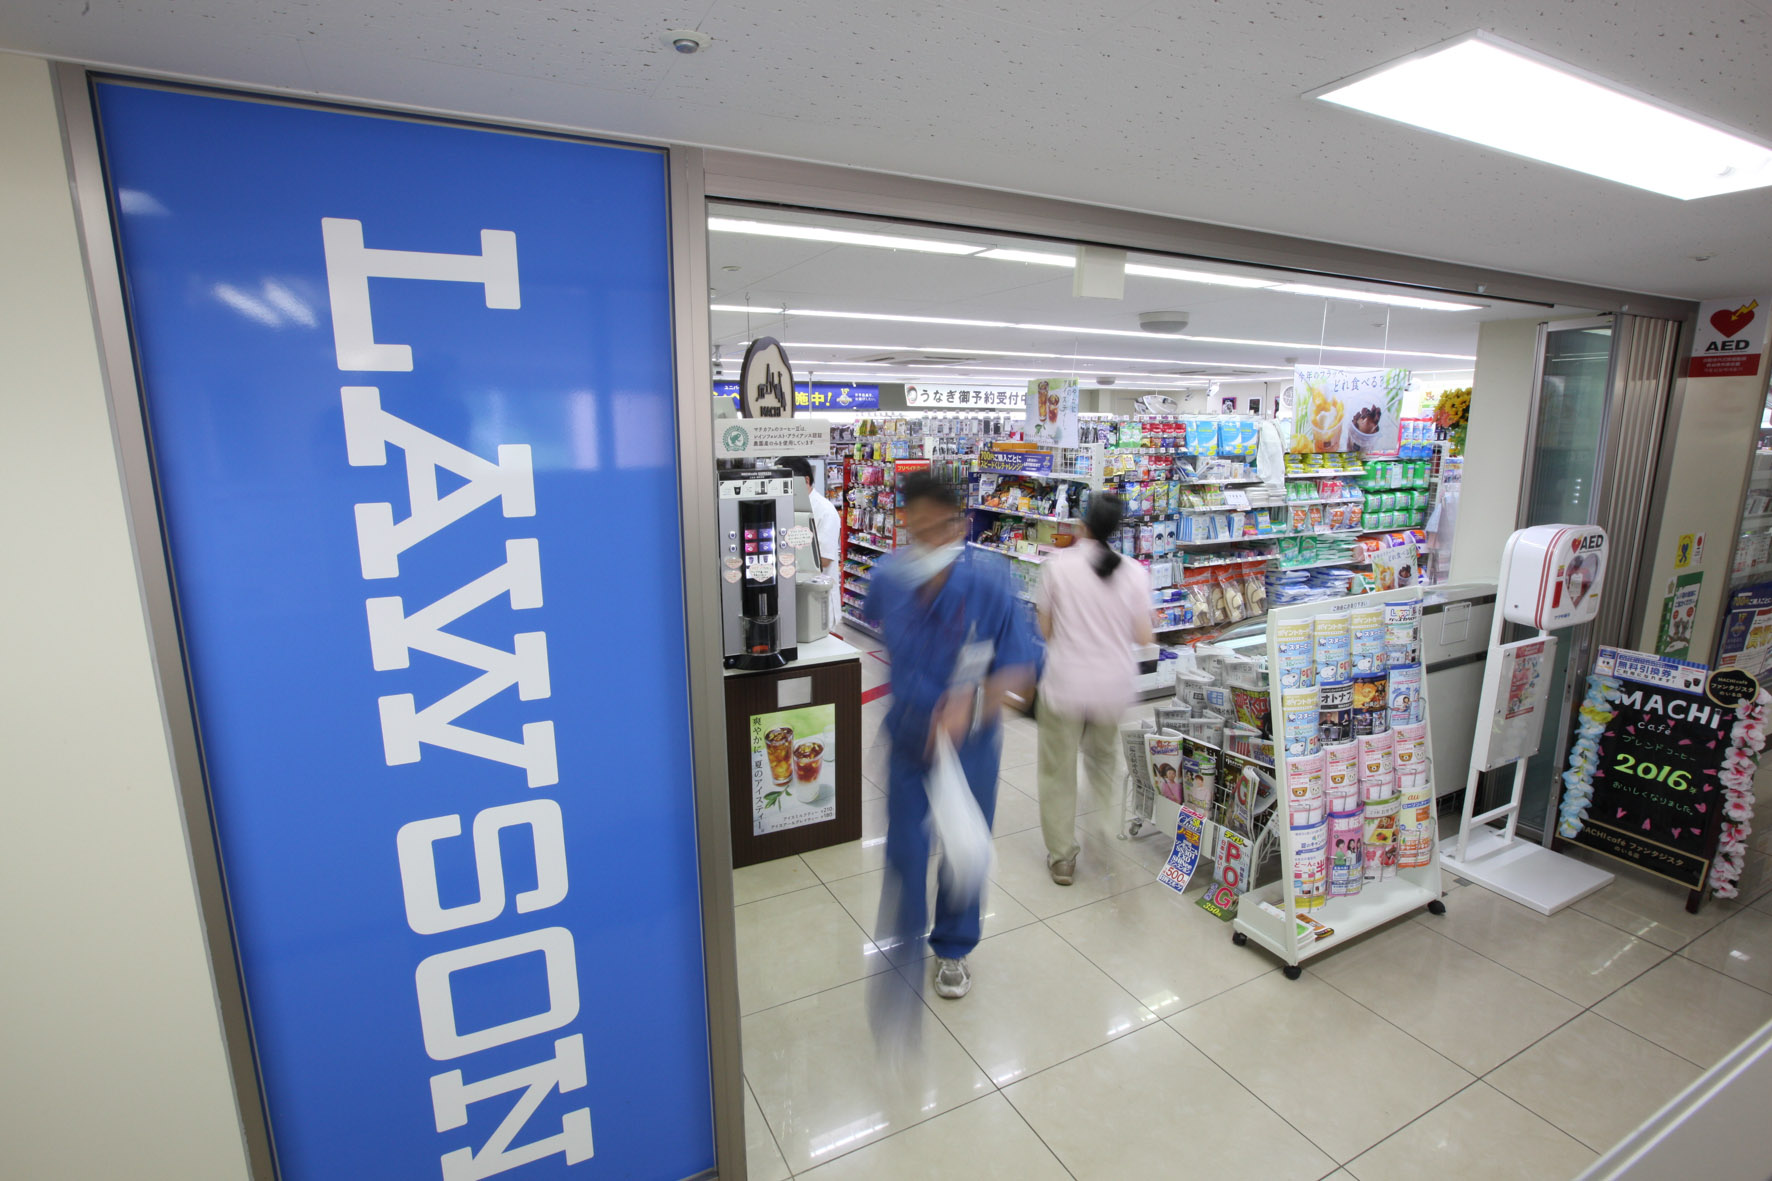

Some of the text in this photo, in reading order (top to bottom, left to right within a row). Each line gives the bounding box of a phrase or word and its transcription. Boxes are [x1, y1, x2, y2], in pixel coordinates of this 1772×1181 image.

[1705, 340, 1750, 352] AED
[1580, 535, 1604, 550] AED
[321, 217, 594, 1181] LAWSON
[1614, 690, 1722, 729] MACHI
[1622, 734, 1696, 761] ブレンドコーヒー
[753, 717, 765, 832] 爽やかに、夏のアイスティー。
[1612, 781, 1693, 816] おいしくなりました。
